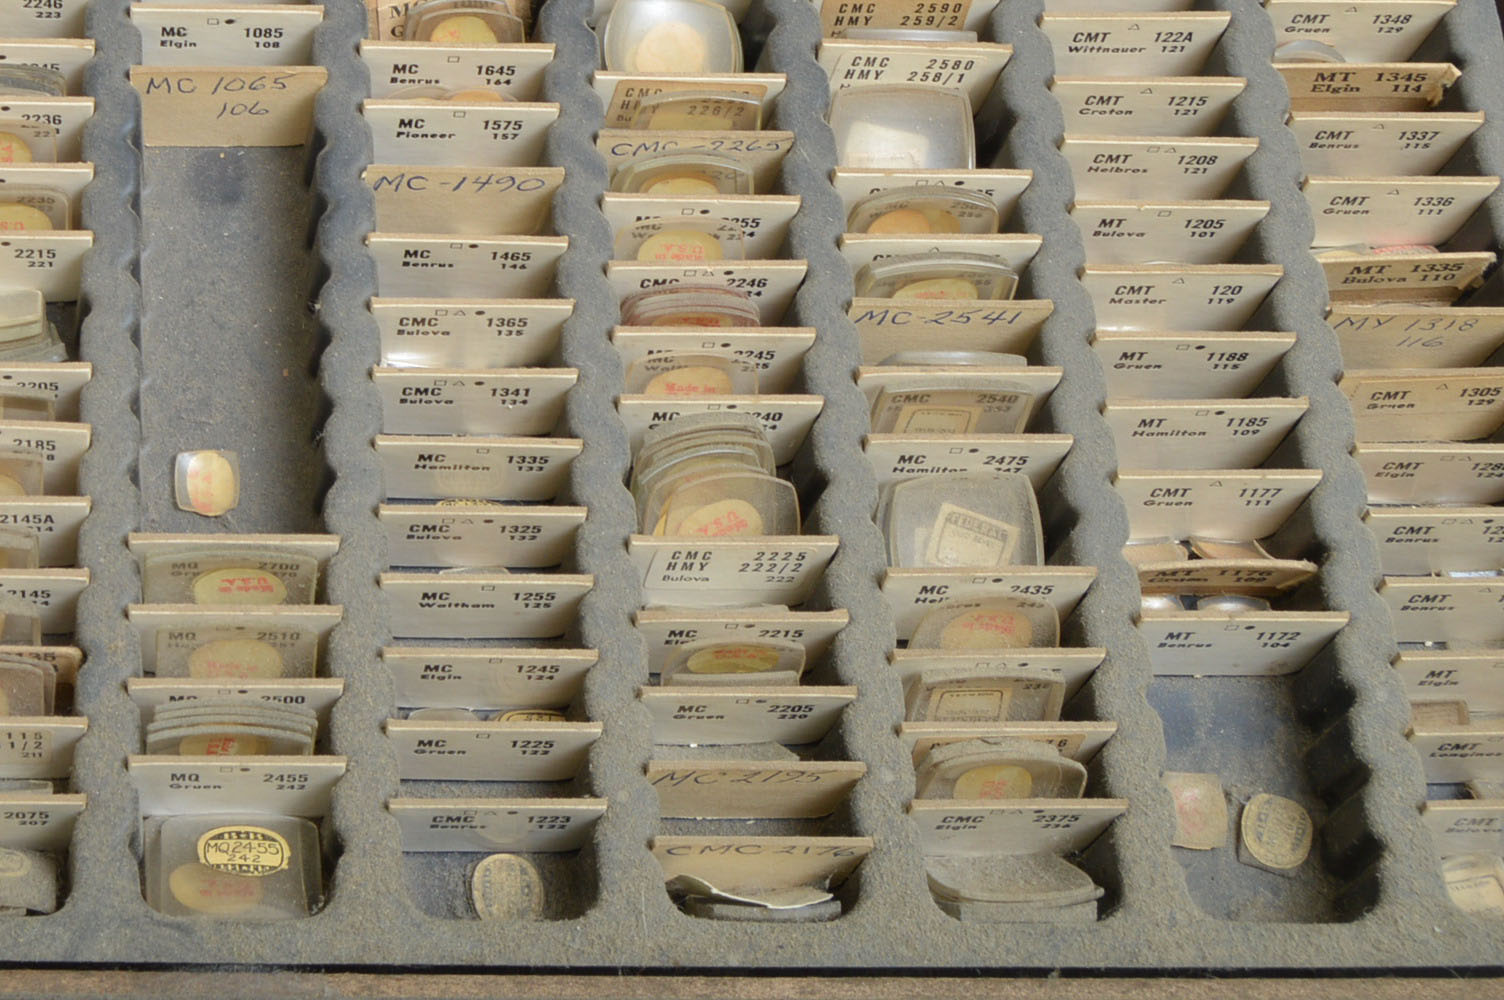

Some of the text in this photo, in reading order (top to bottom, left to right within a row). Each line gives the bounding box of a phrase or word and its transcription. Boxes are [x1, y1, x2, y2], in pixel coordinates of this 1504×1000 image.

[834, 16, 958, 28] HMY 259/2
[162, 27, 283, 38] MC 1085
[1073, 32, 1193, 43] CMT 122A
[851, 56, 974, 70] CMC 2580
[393, 64, 515, 76] MC 1645
[844, 69, 964, 85] HMY 258/1
[1314, 72, 1427, 82] MT 1345
[1311, 84, 1360, 94] Elgin
[1085, 96, 1208, 106] CMT 1215
[1315, 130, 1440, 140] CMT 1337
[15, 249, 56, 258] 2215
[1138, 417, 1269, 428] MT 1185
[672, 551, 807, 561] CMC 2225
[666, 562, 708, 571] HMY
[171, 773, 199, 782] MQ
[226, 854, 262, 863] 242
